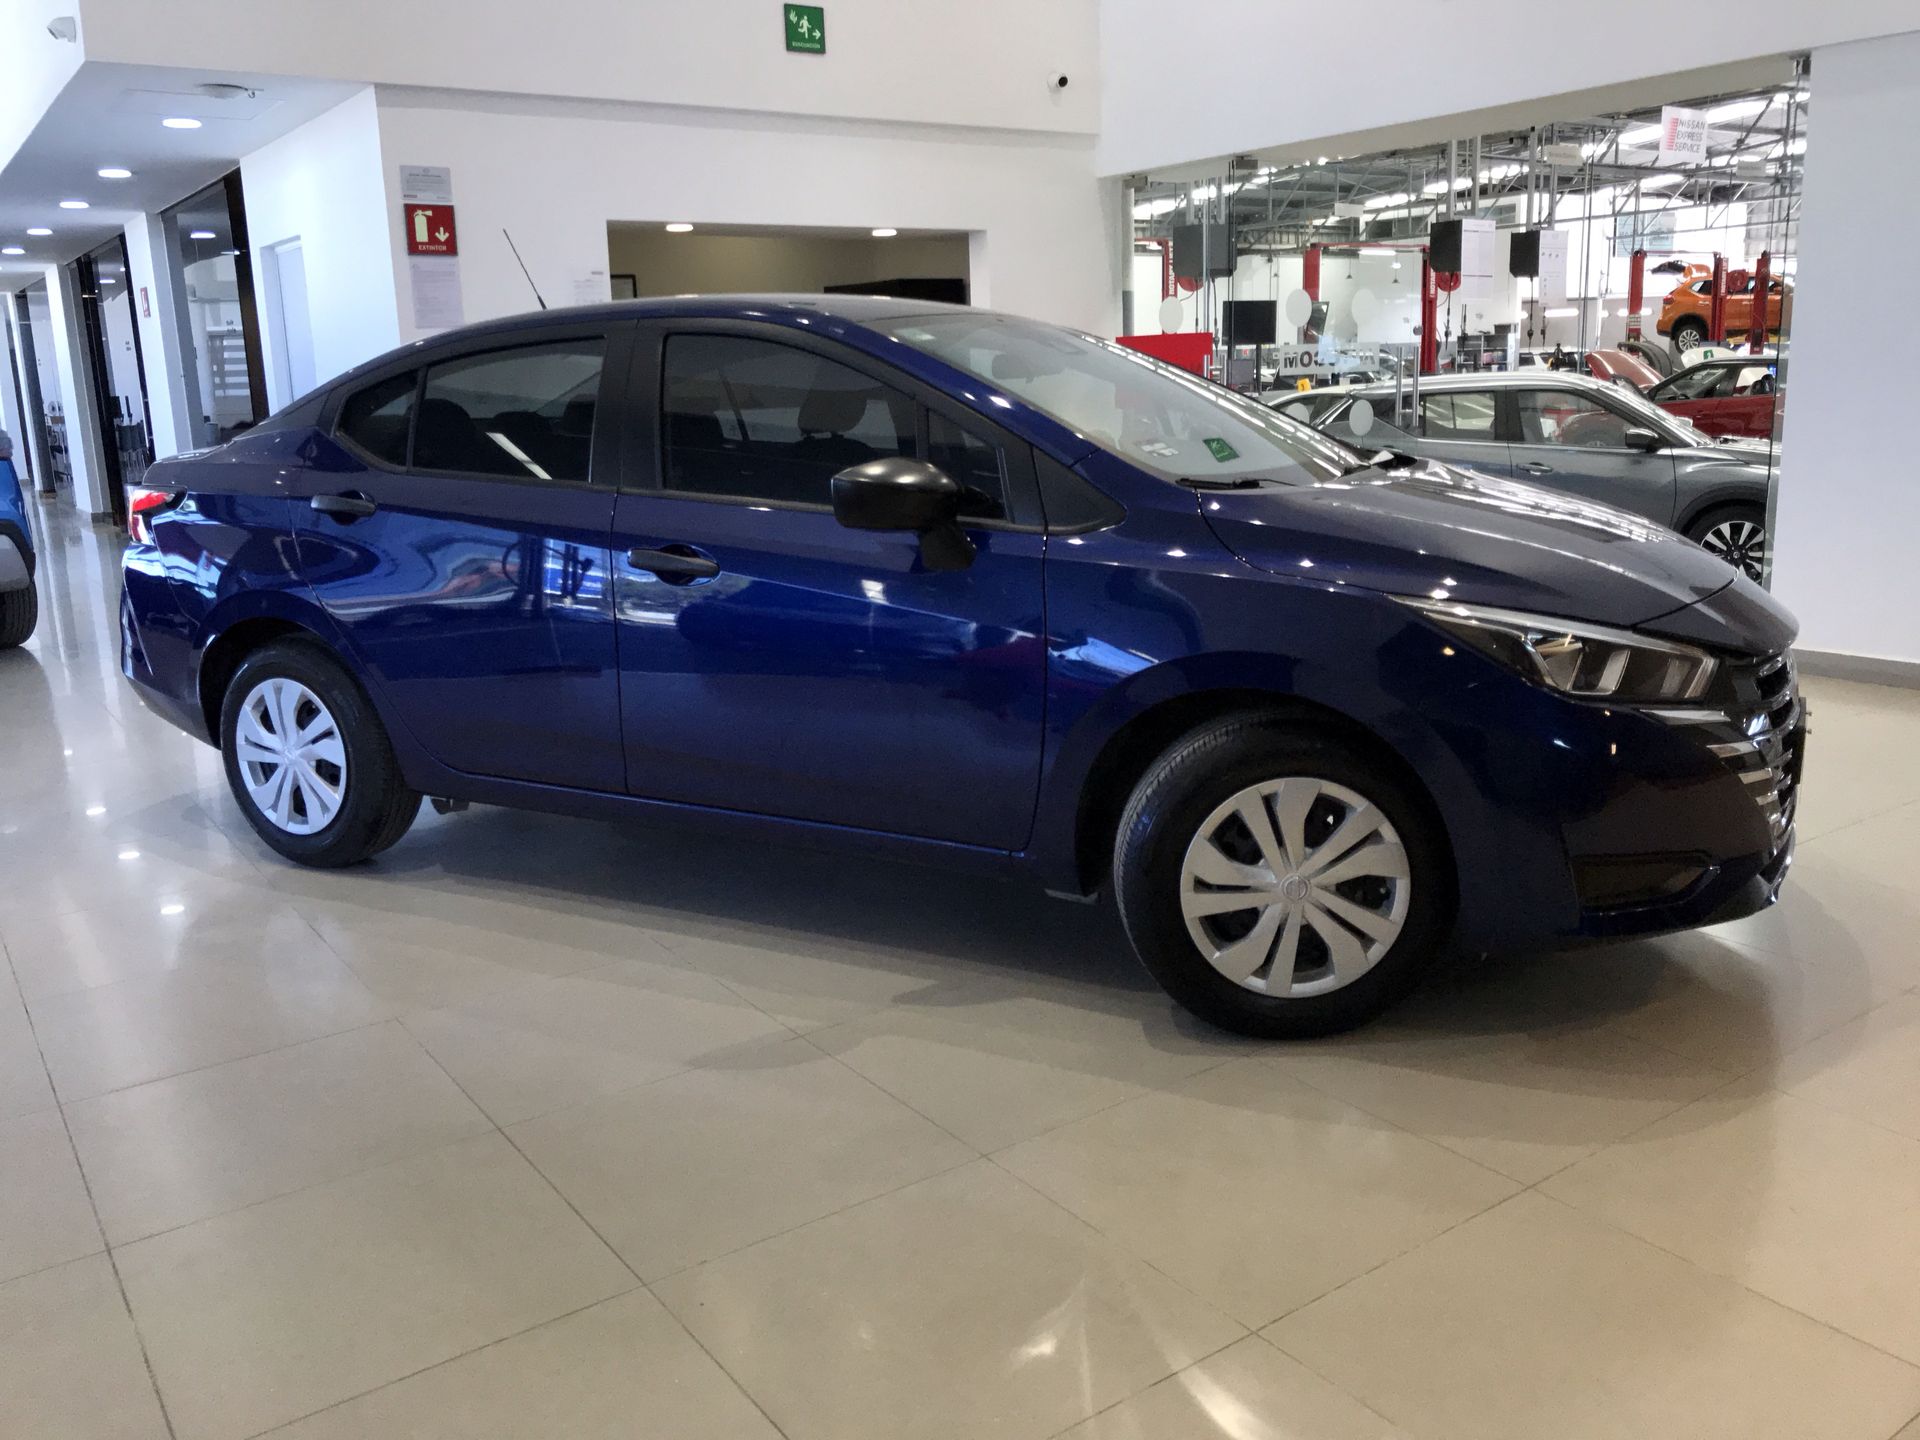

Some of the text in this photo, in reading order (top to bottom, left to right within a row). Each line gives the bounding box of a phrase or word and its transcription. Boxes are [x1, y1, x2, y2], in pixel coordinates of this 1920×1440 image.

[1679, 119, 1705, 130] NISSAN
[1677, 130, 1703, 142] EXPRESS
[1675, 142, 1701, 153] SERVICE
